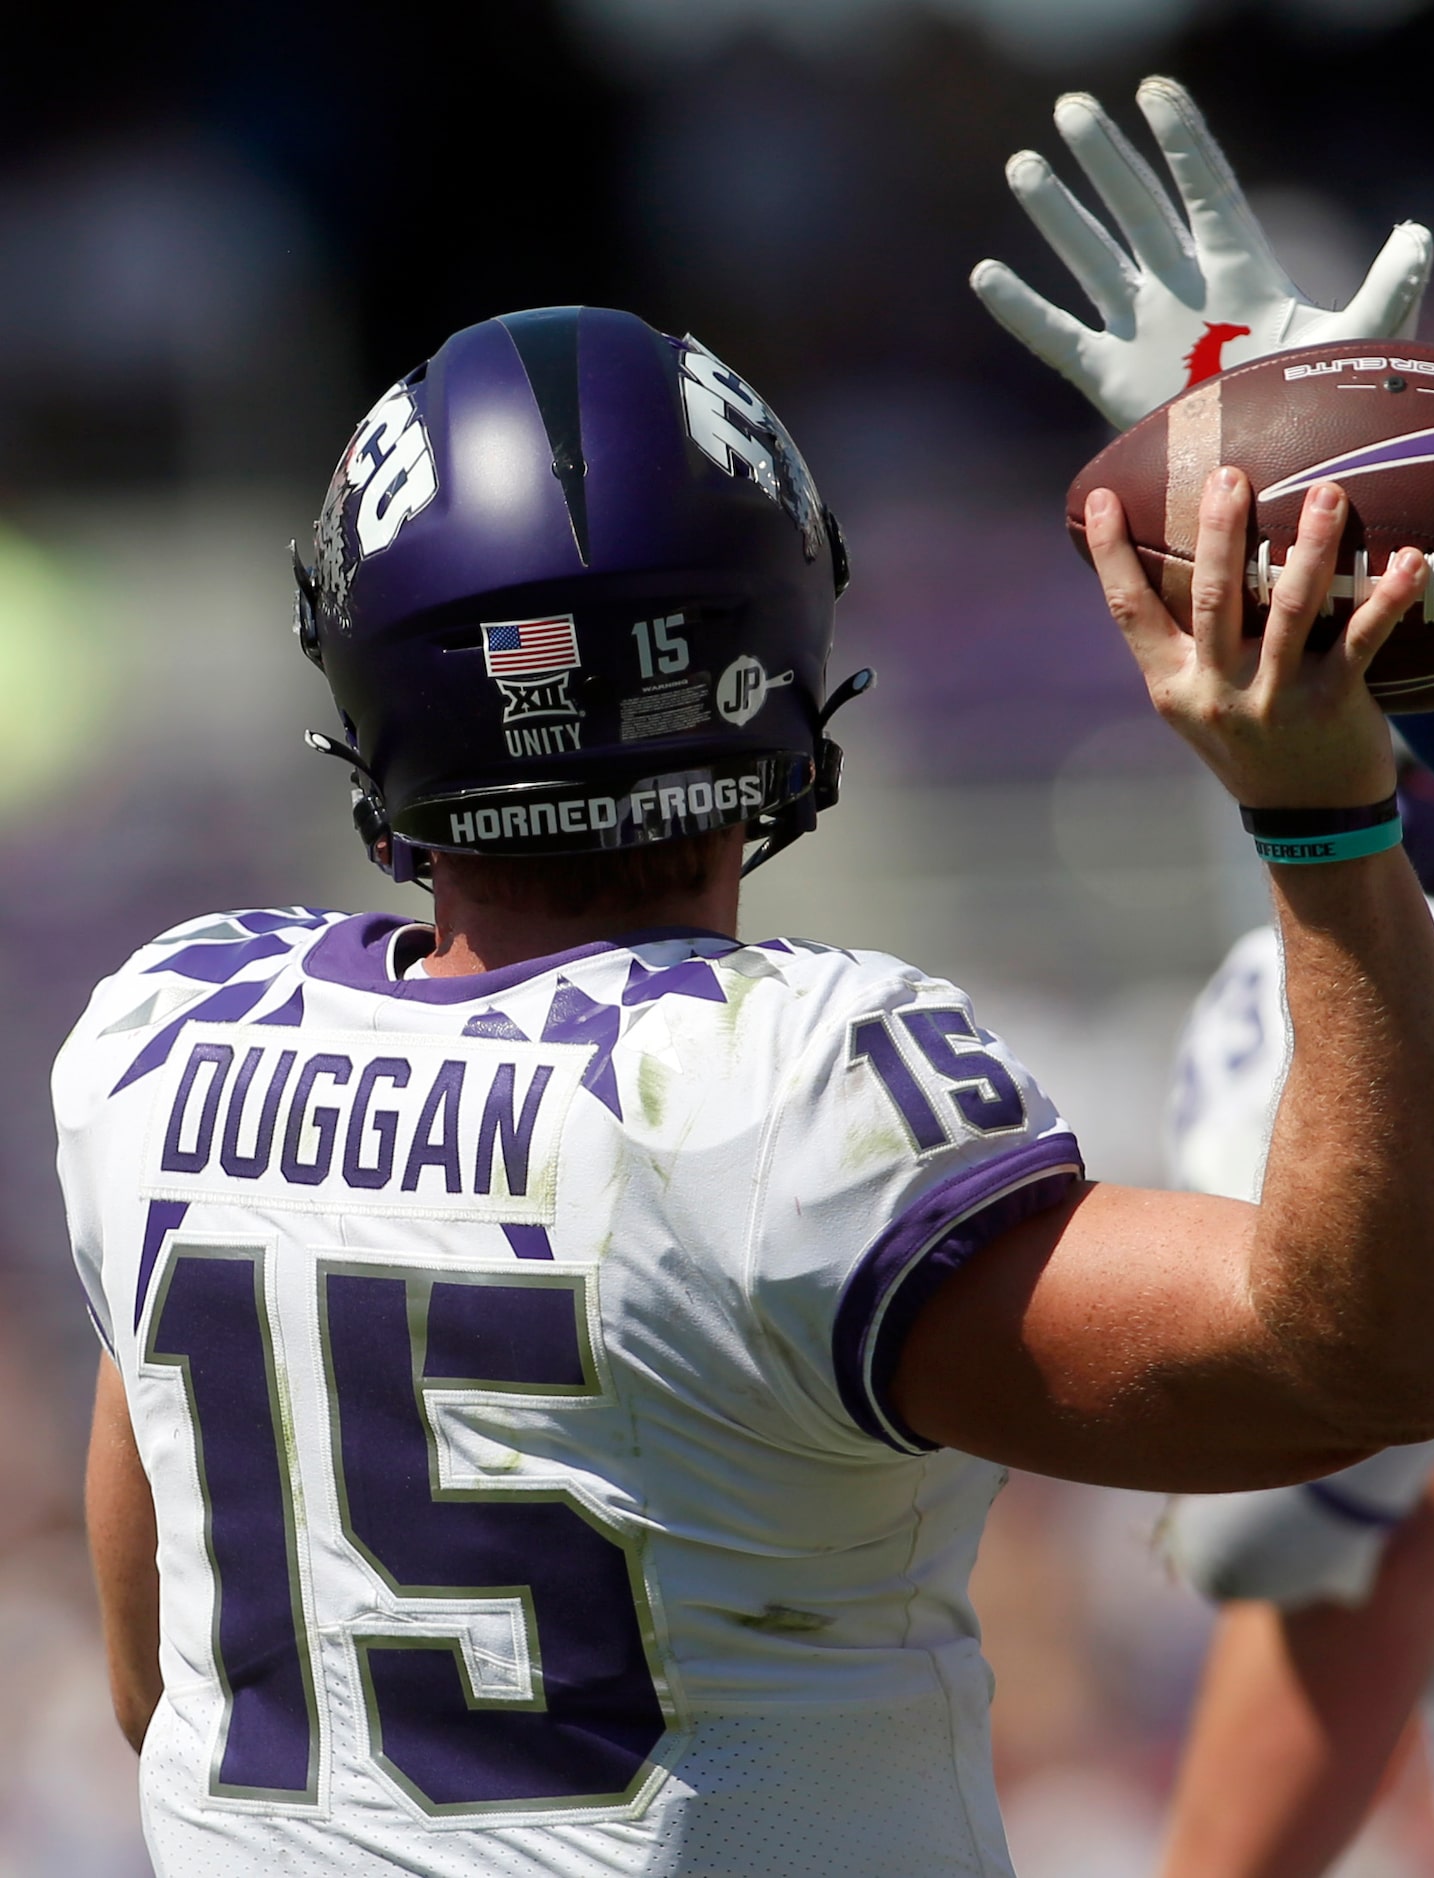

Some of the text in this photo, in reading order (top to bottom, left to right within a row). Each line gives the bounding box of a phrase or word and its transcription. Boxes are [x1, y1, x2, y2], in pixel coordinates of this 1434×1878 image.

[1283, 357, 1388, 381] ELITE
[631, 613, 690, 679] 15
[642, 679, 689, 693] WARNING
[723, 666, 760, 714] JP
[505, 722, 581, 757] UNITY
[450, 775, 763, 843] HORNED FROGS
[845, 1006, 1032, 1164] 15
[162, 1043, 554, 1197] DUGGAN
[141, 1234, 686, 1826] 15
